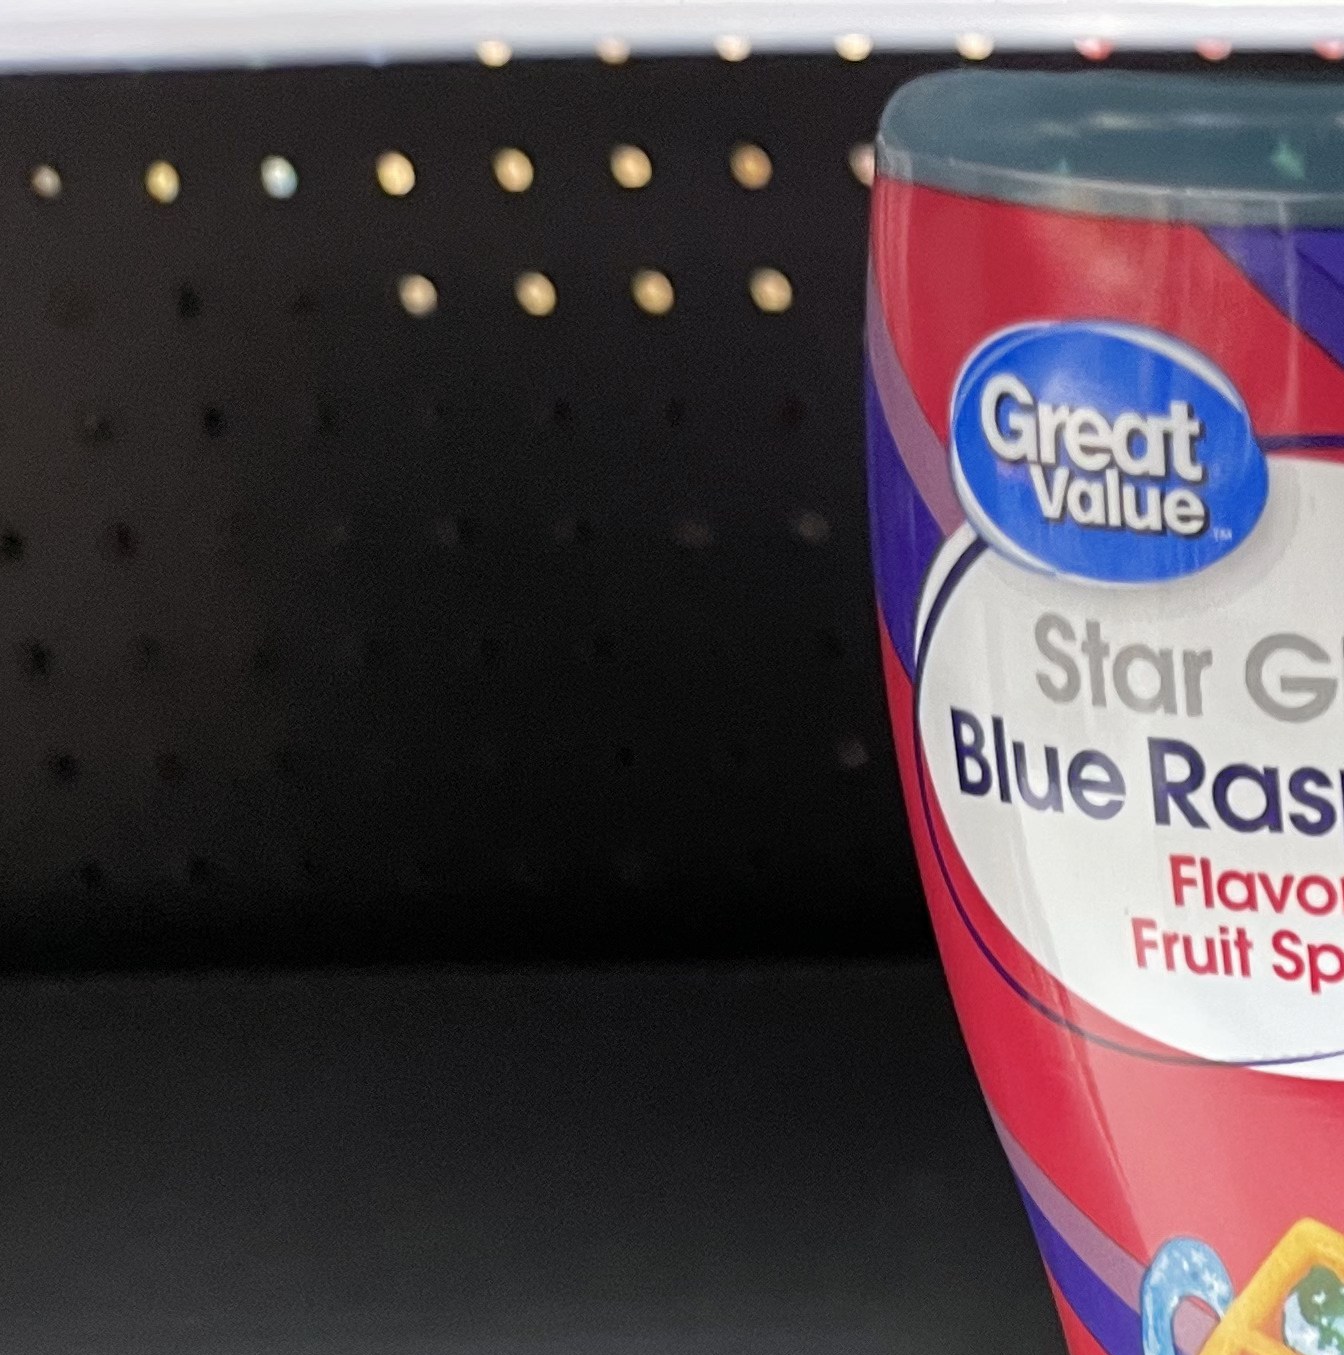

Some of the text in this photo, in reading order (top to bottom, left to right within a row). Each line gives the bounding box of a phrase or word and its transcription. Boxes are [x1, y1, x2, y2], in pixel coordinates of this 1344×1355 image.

[982, 376, 1204, 482] Great
[1031, 463, 1206, 535] Value
[1034, 611, 1214, 716] Star
[950, 707, 1126, 821] Blue
[1130, 918, 1255, 978] Fruit
